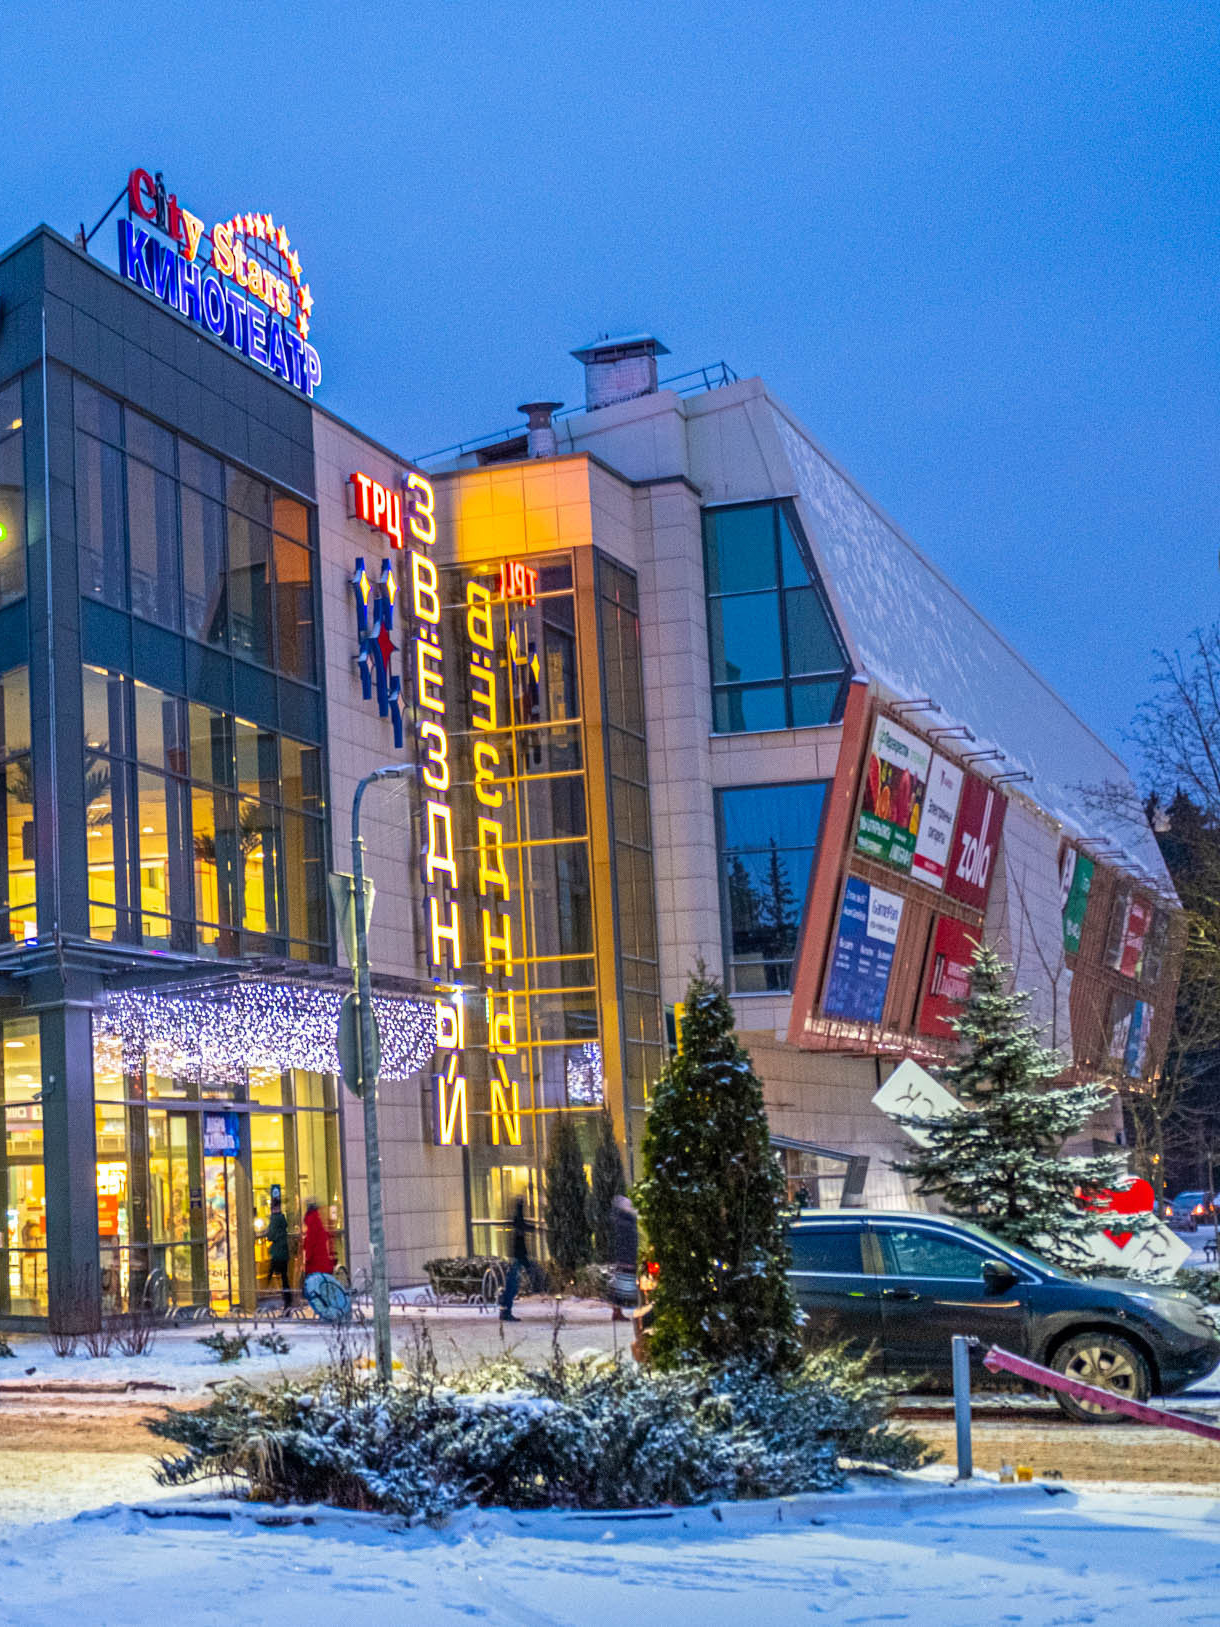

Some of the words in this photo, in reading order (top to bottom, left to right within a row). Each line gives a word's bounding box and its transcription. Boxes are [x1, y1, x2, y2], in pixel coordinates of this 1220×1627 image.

[118, 219, 322, 399] КИНОТЕАТР
[127, 168, 204, 262] City
[211, 222, 291, 318] Stars
[350, 471, 404, 549] ТРЦ
[406, 471, 470, 1146] ЗВЁЗДНЫЙ
